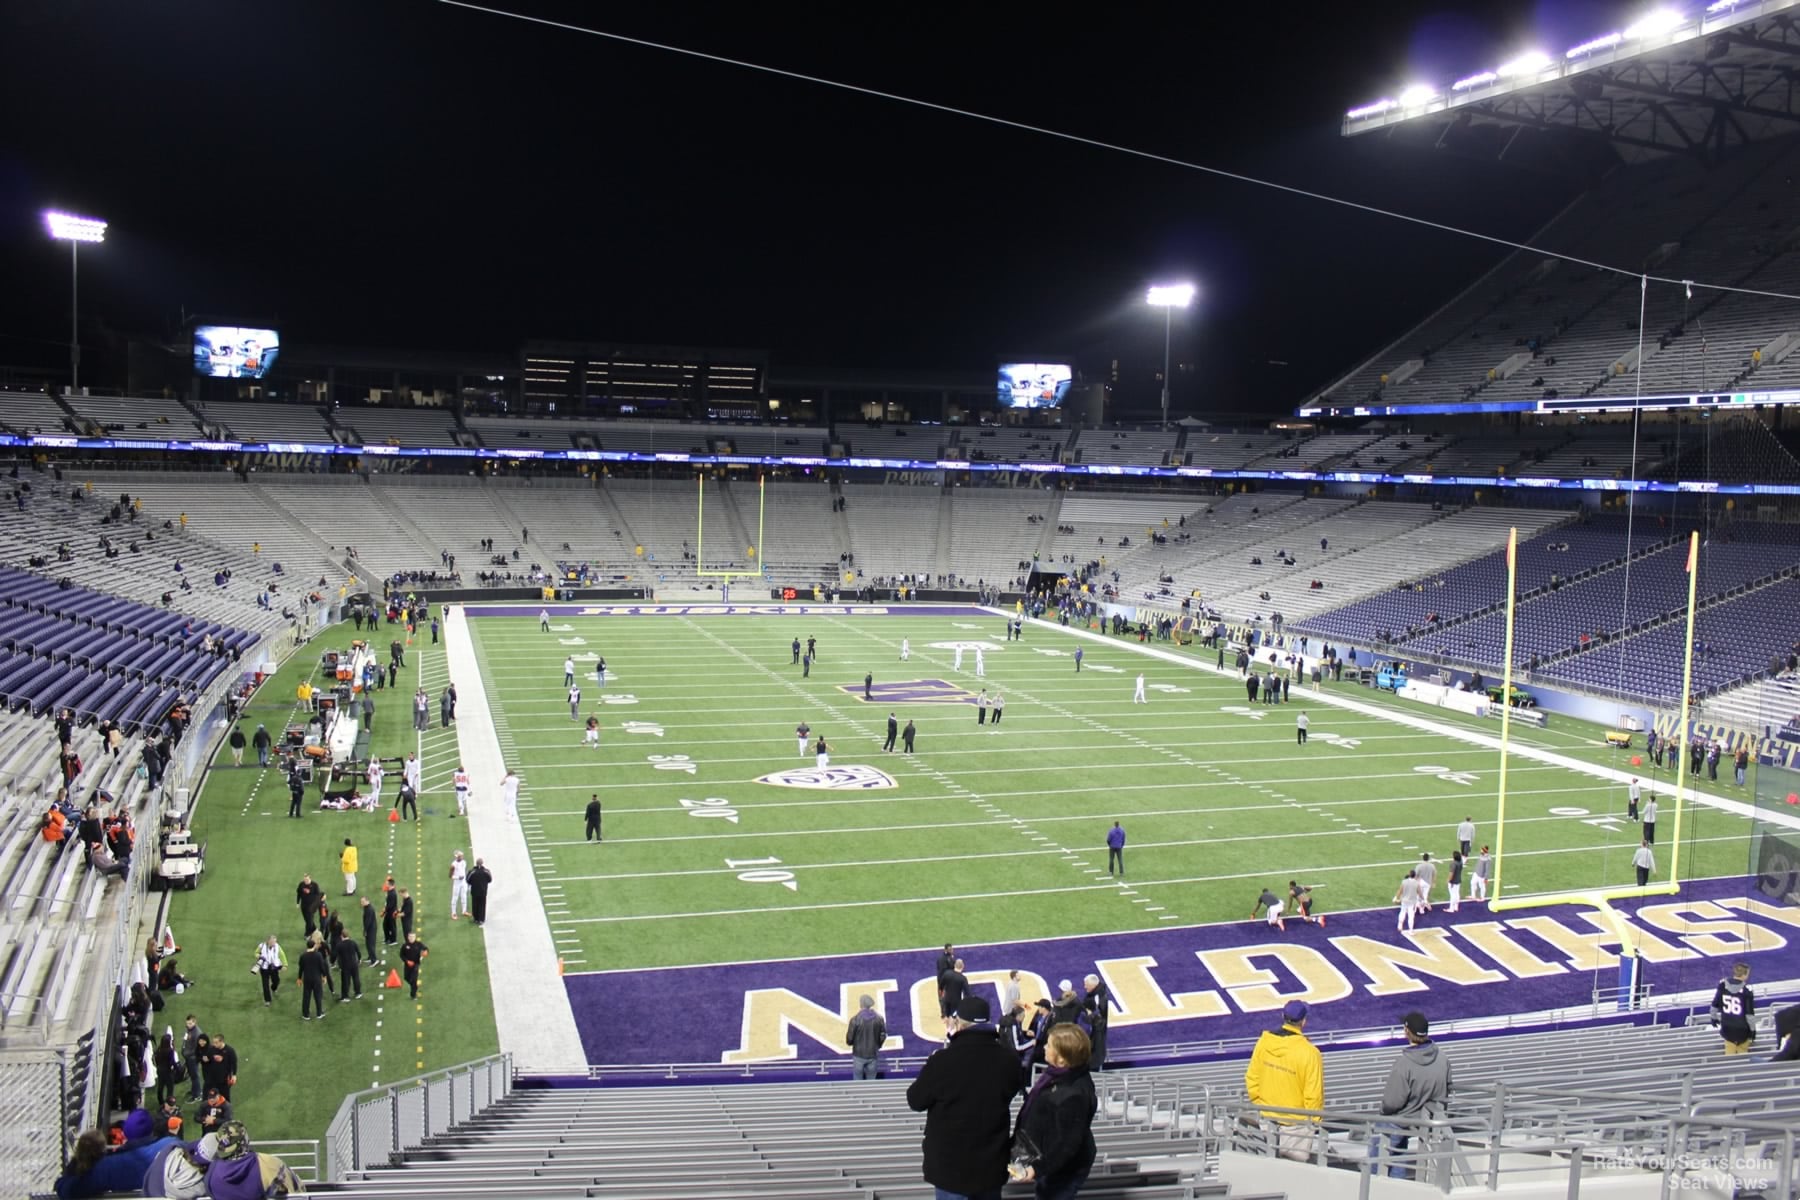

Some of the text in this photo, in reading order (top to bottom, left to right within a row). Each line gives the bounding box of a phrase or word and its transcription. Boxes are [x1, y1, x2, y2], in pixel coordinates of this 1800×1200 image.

[783, 589, 796, 599] 25
[577, 606, 889, 616] HUSKIES
[647, 754, 697, 770] 30
[678, 797, 739, 818] 20
[724, 855, 795, 882] 10
[1722, 994, 1742, 1015] 56
